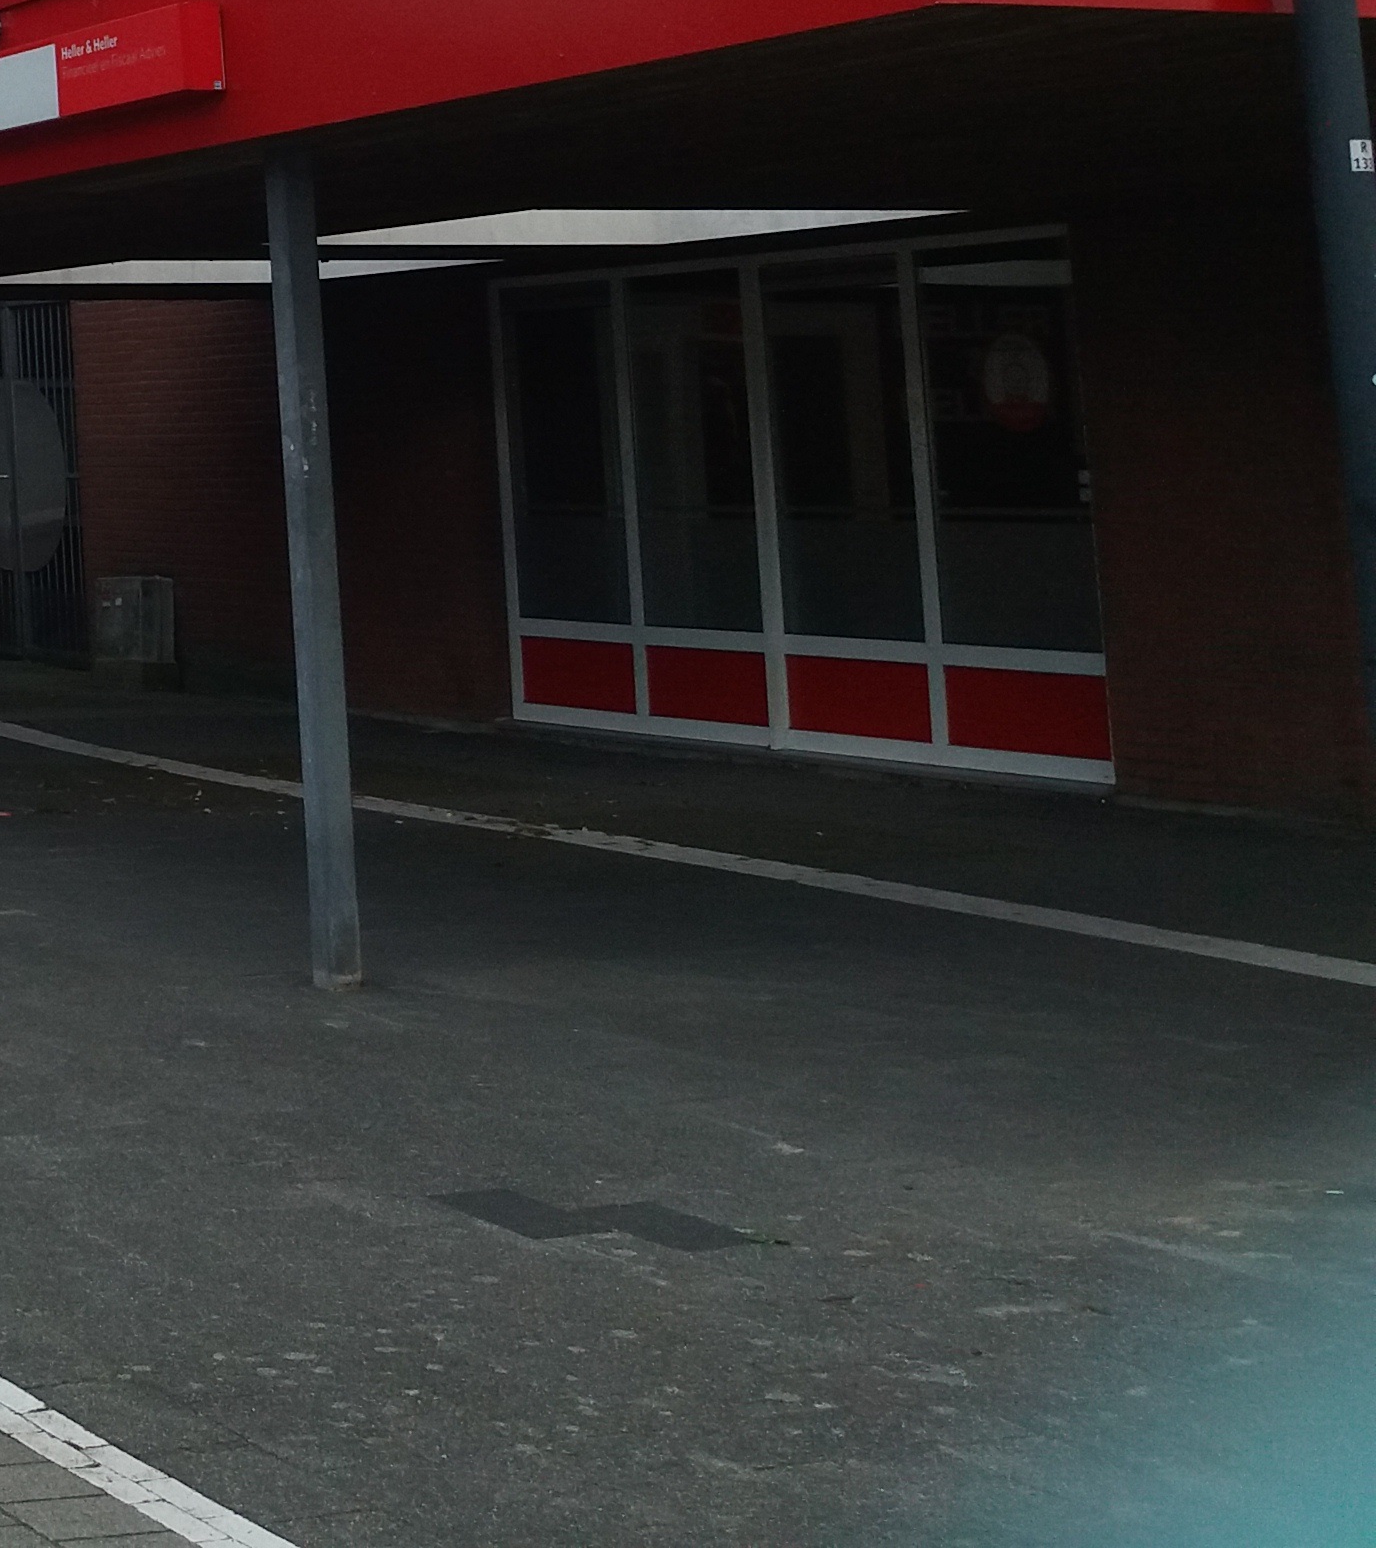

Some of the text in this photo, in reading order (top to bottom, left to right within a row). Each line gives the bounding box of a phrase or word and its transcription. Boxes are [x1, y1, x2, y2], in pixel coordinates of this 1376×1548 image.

[61, 35, 118, 61] Heller & Heller
